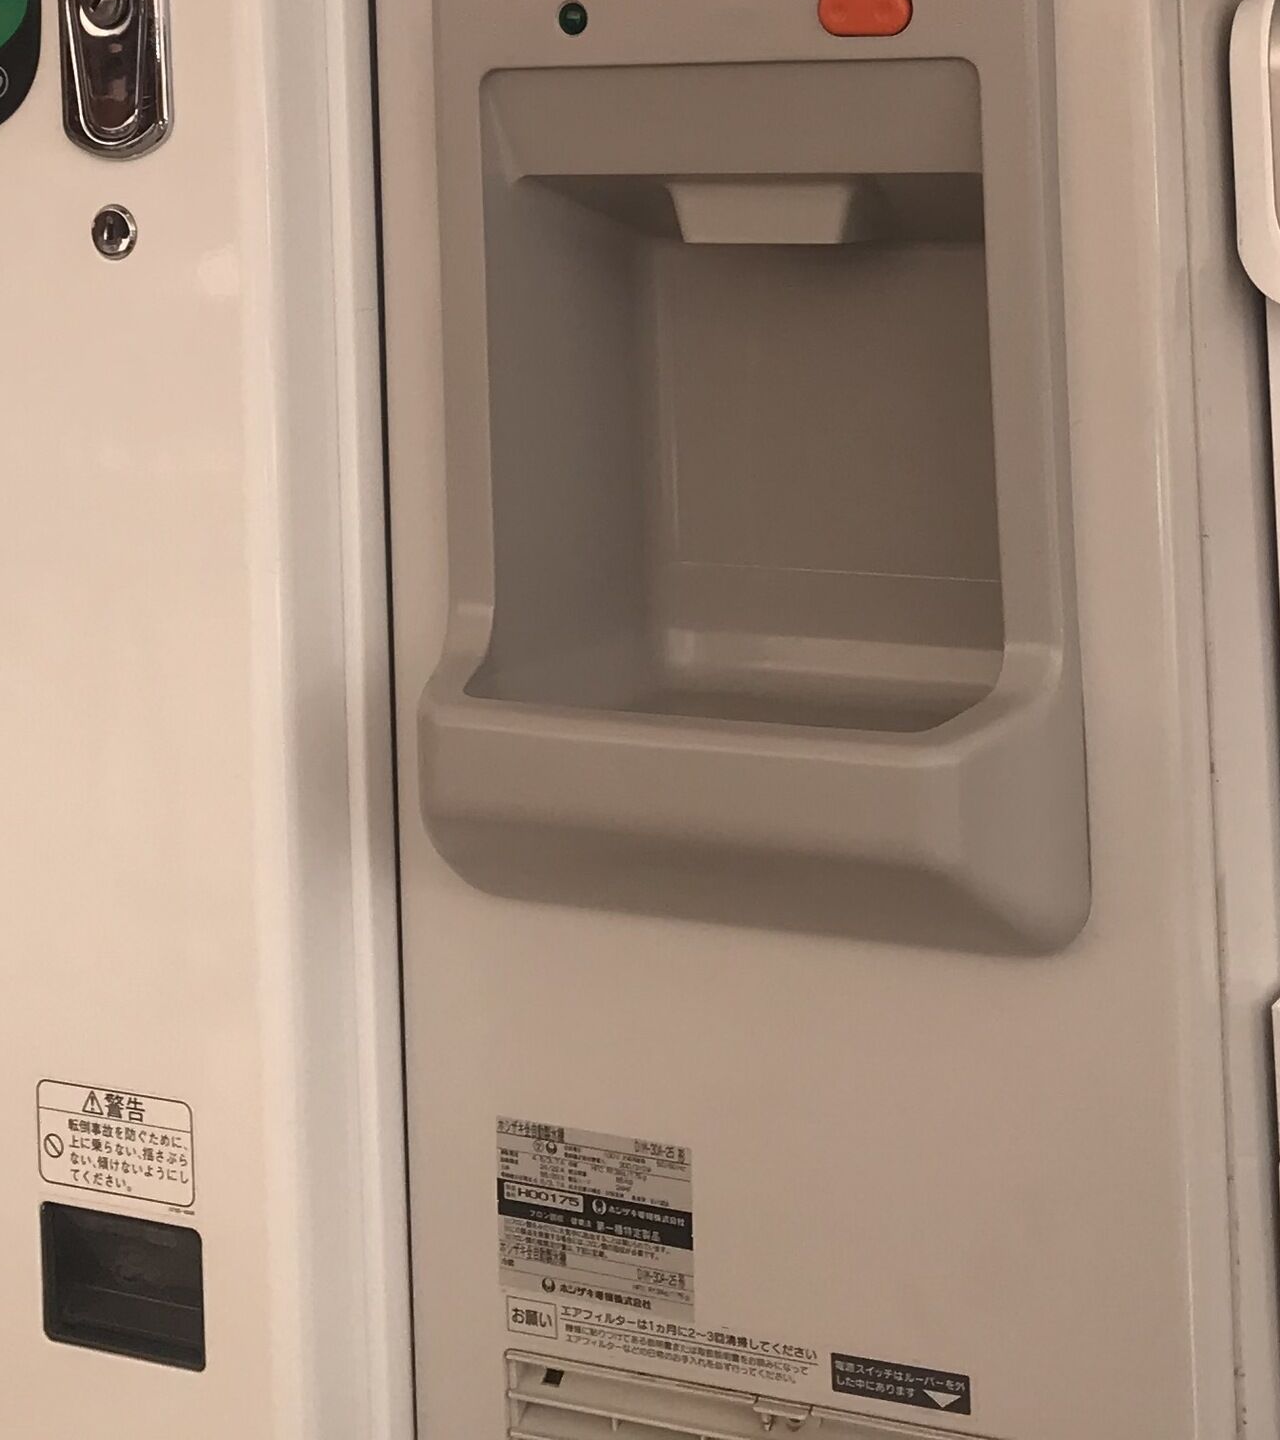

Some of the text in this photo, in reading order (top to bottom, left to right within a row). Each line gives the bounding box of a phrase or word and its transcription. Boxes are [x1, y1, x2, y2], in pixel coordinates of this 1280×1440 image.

[104, 1093, 146, 1122] 警告
[70, 1167, 133, 1193] てください。
[511, 1307, 553, 1329] お願い
[836, 1374, 916, 1399] した中にあります
